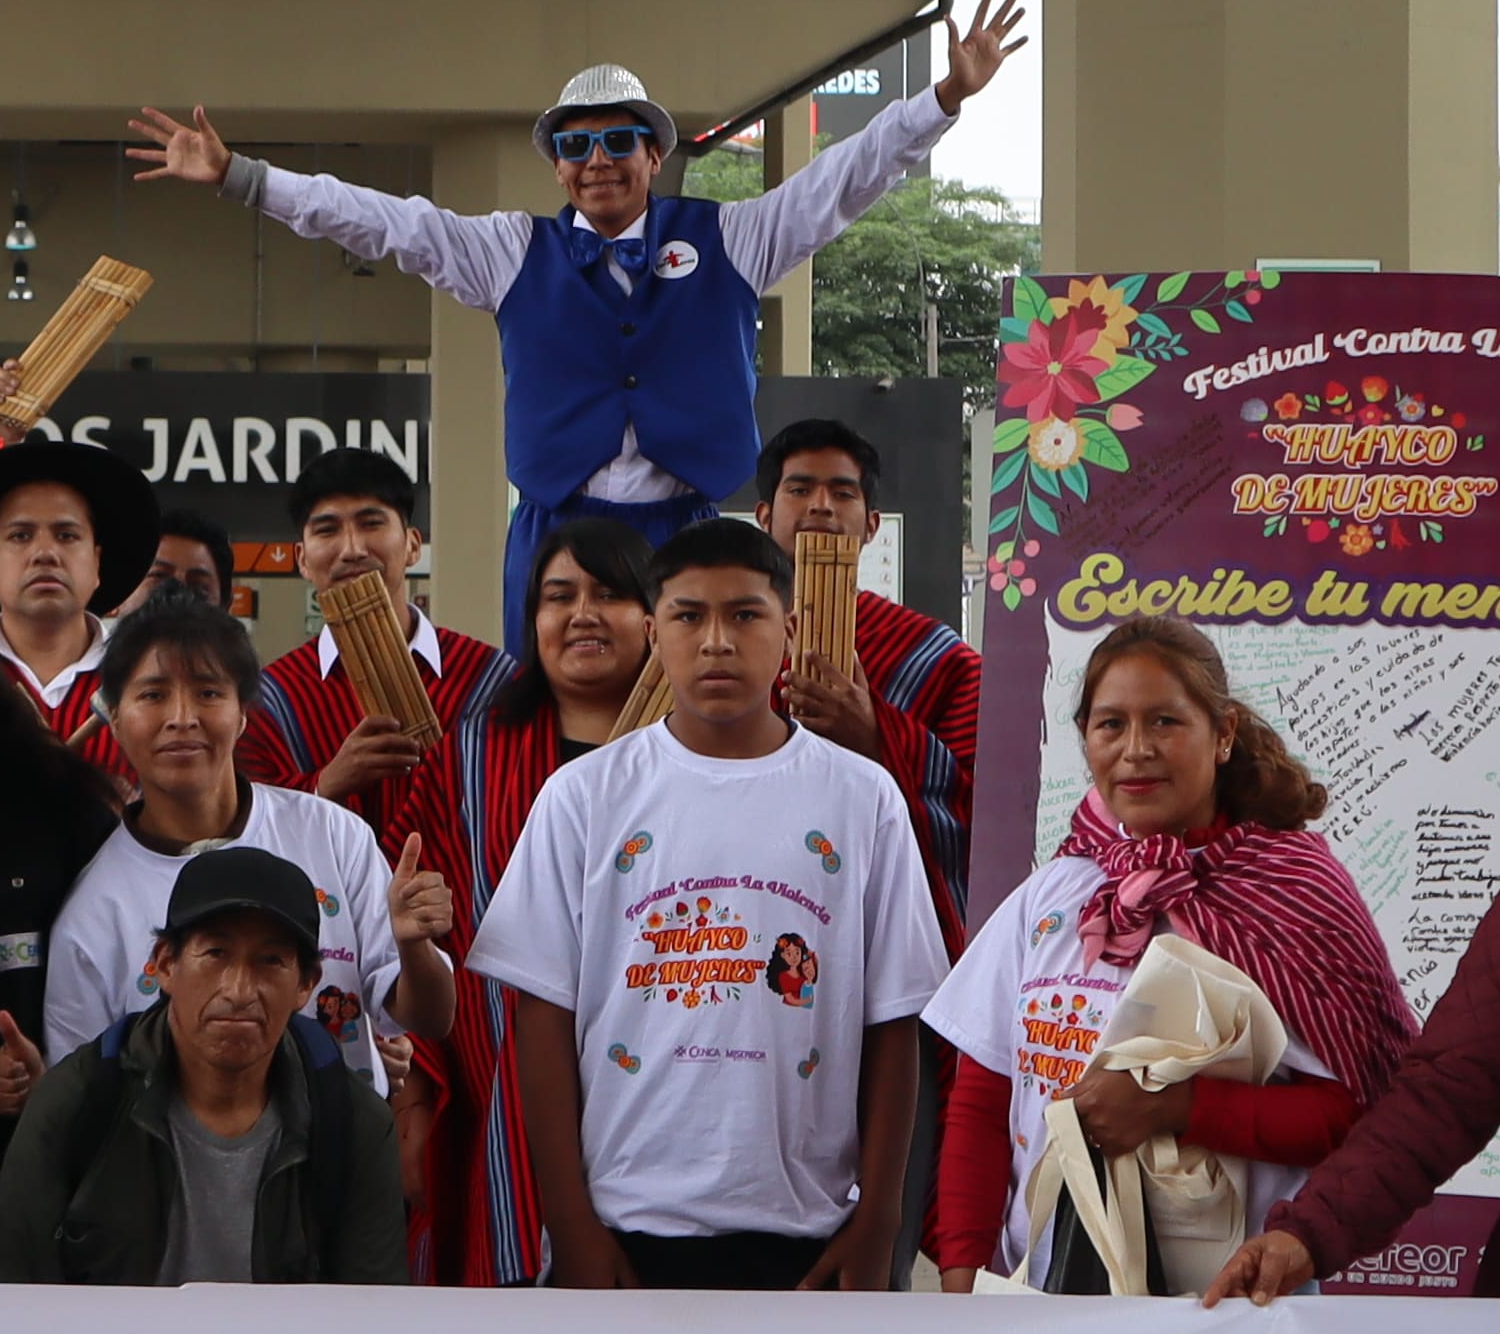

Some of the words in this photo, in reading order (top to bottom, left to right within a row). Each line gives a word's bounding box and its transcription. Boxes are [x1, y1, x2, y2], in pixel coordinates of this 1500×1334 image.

[1183, 332, 1330, 401] Festival
[1333, 327, 1466, 356] Contra
[142, 417, 431, 484] JARDIN
[1231, 474, 1292, 515] DE
[1056, 552, 1295, 625] Escribe
[1304, 570, 1368, 618] tu
[741, 875, 764, 890] La
